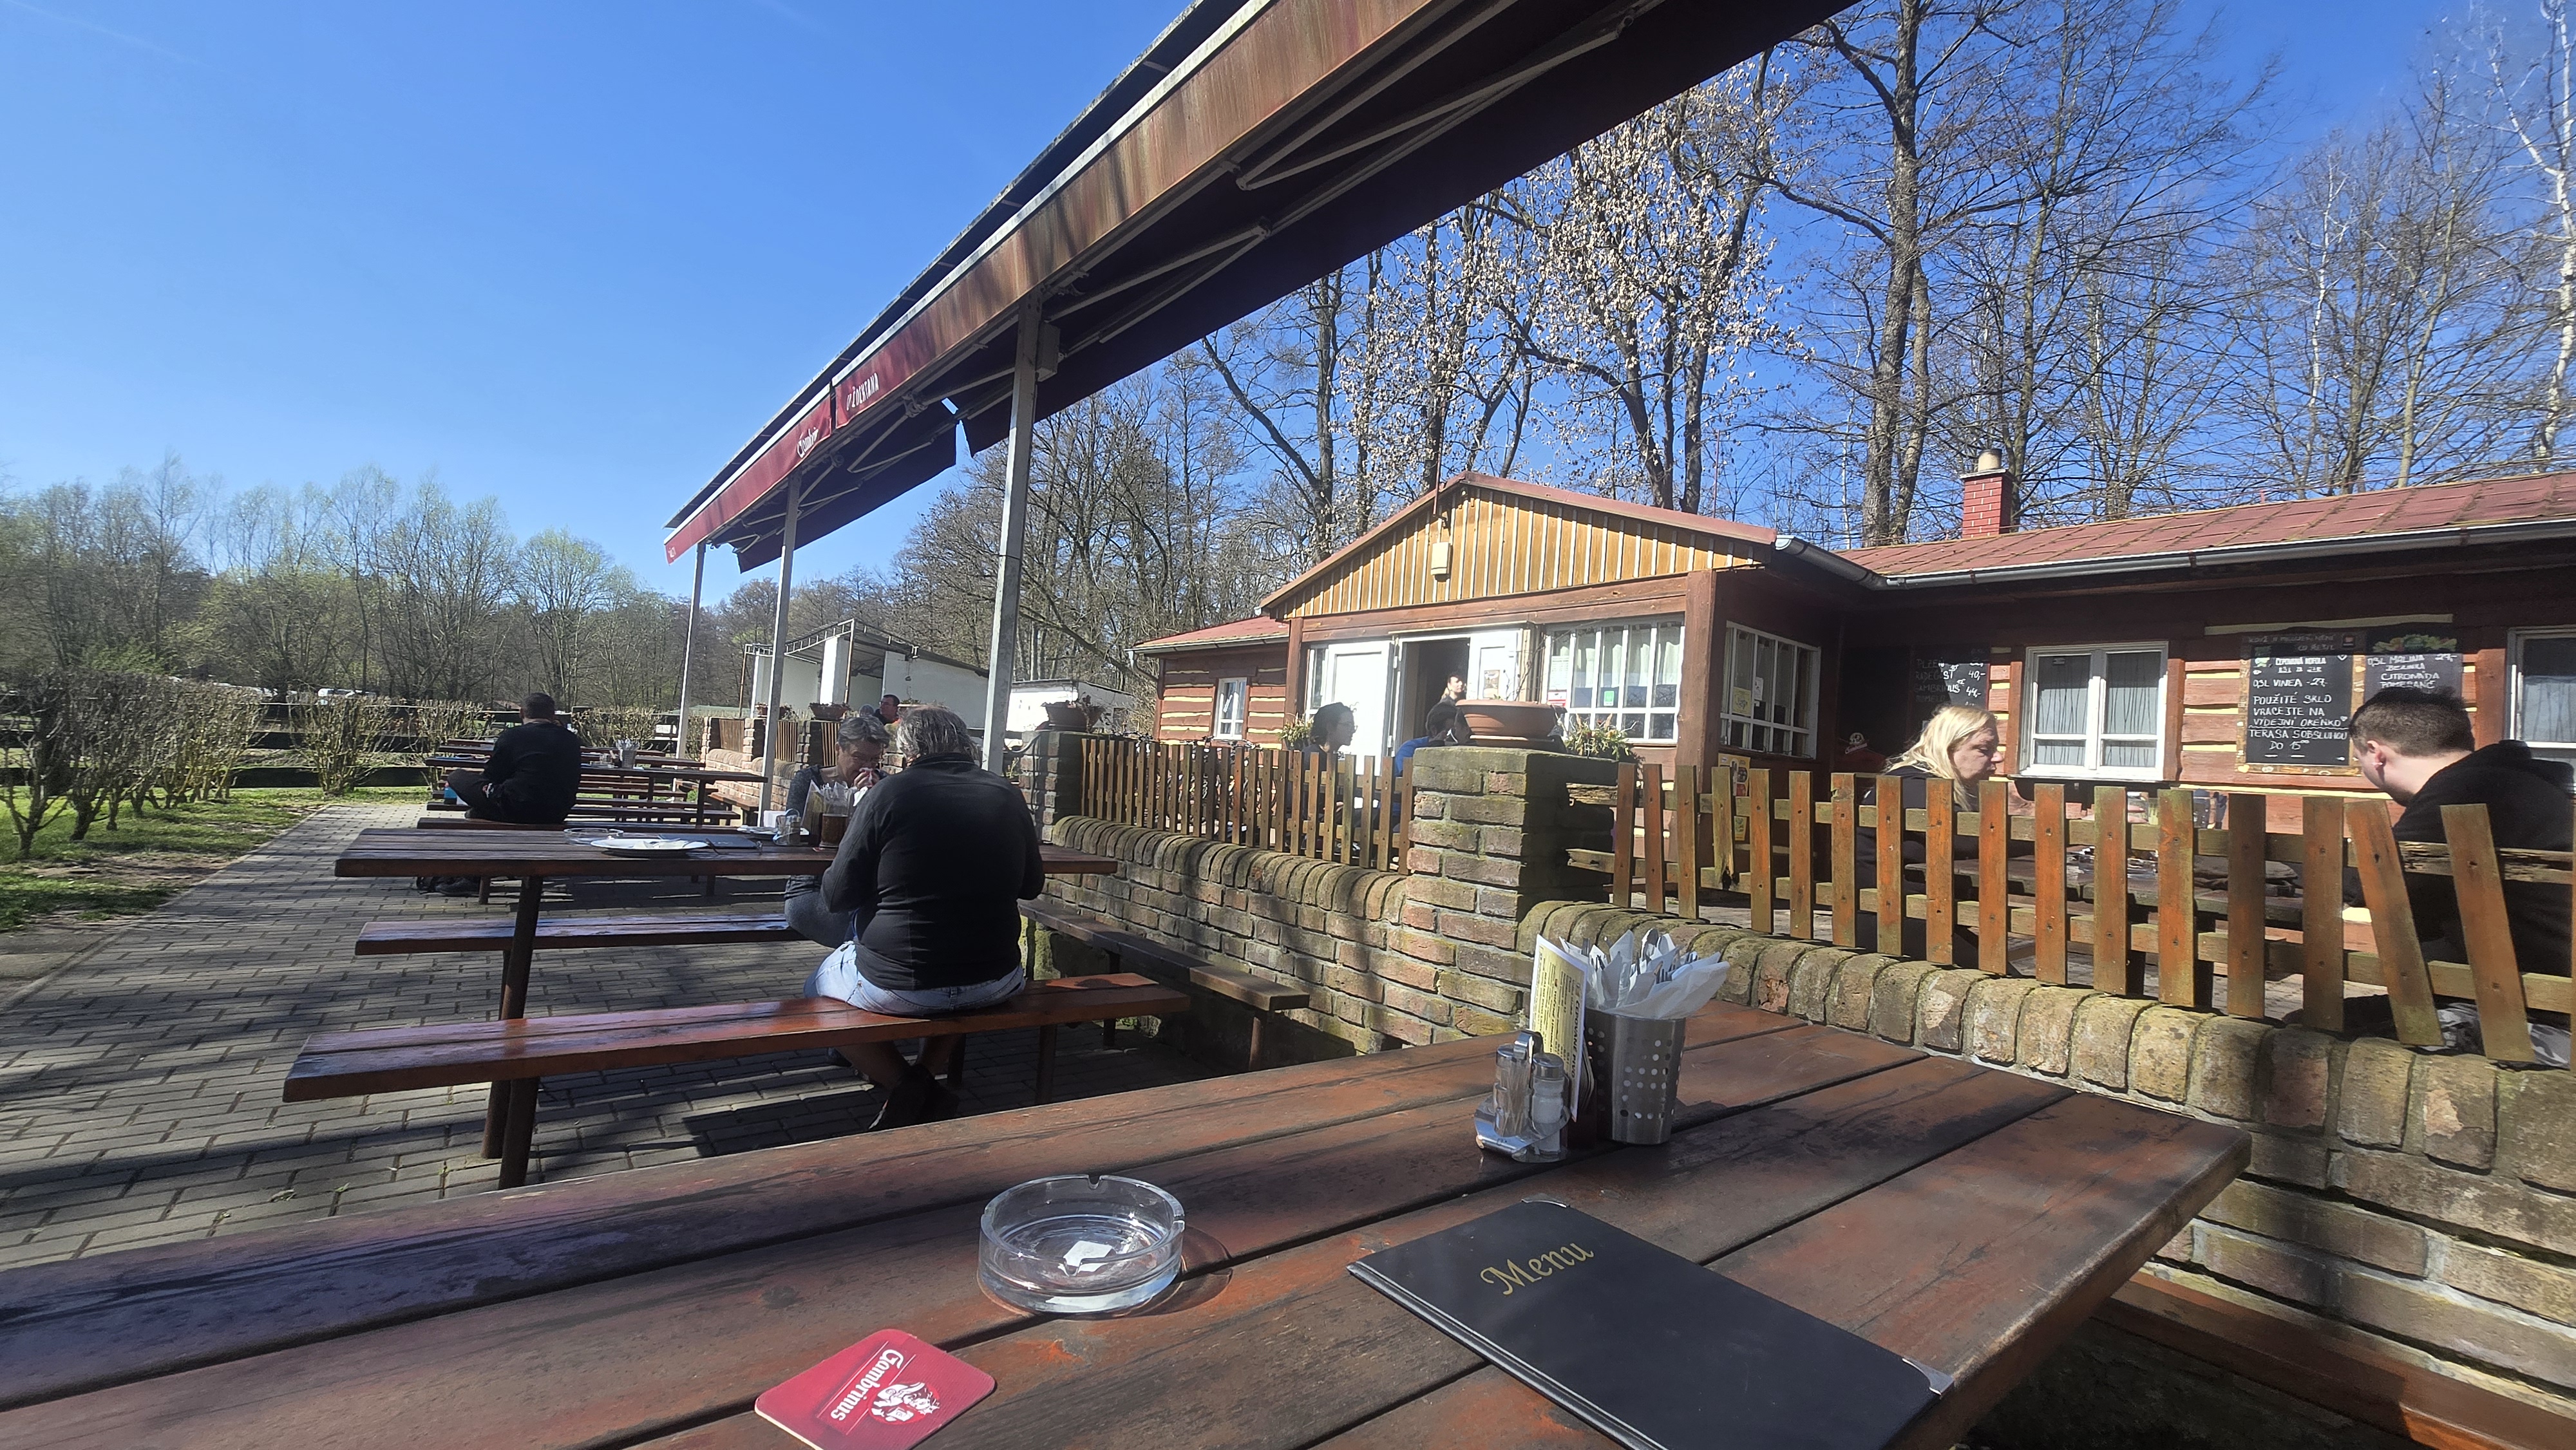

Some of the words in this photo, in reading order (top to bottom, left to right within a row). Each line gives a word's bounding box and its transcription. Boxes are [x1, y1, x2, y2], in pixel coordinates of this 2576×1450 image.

[2389, 654, 2425, 664] MALINA
[2273, 678, 2303, 687] VINEA
[2253, 692, 2298, 705] POUŽITÉ
[2303, 694, 2333, 704] SKLO
[2253, 707, 2304, 716] VRACEJTE
[2309, 707, 2325, 717] NA
[2253, 717, 2297, 726] VÝDEJNÍ
[2247, 728, 2289, 739] TERASA
[2269, 740, 2284, 750] DO
[1480, 1243, 1595, 1295] Menu
[830, 1349, 904, 1421] Gambrinus
